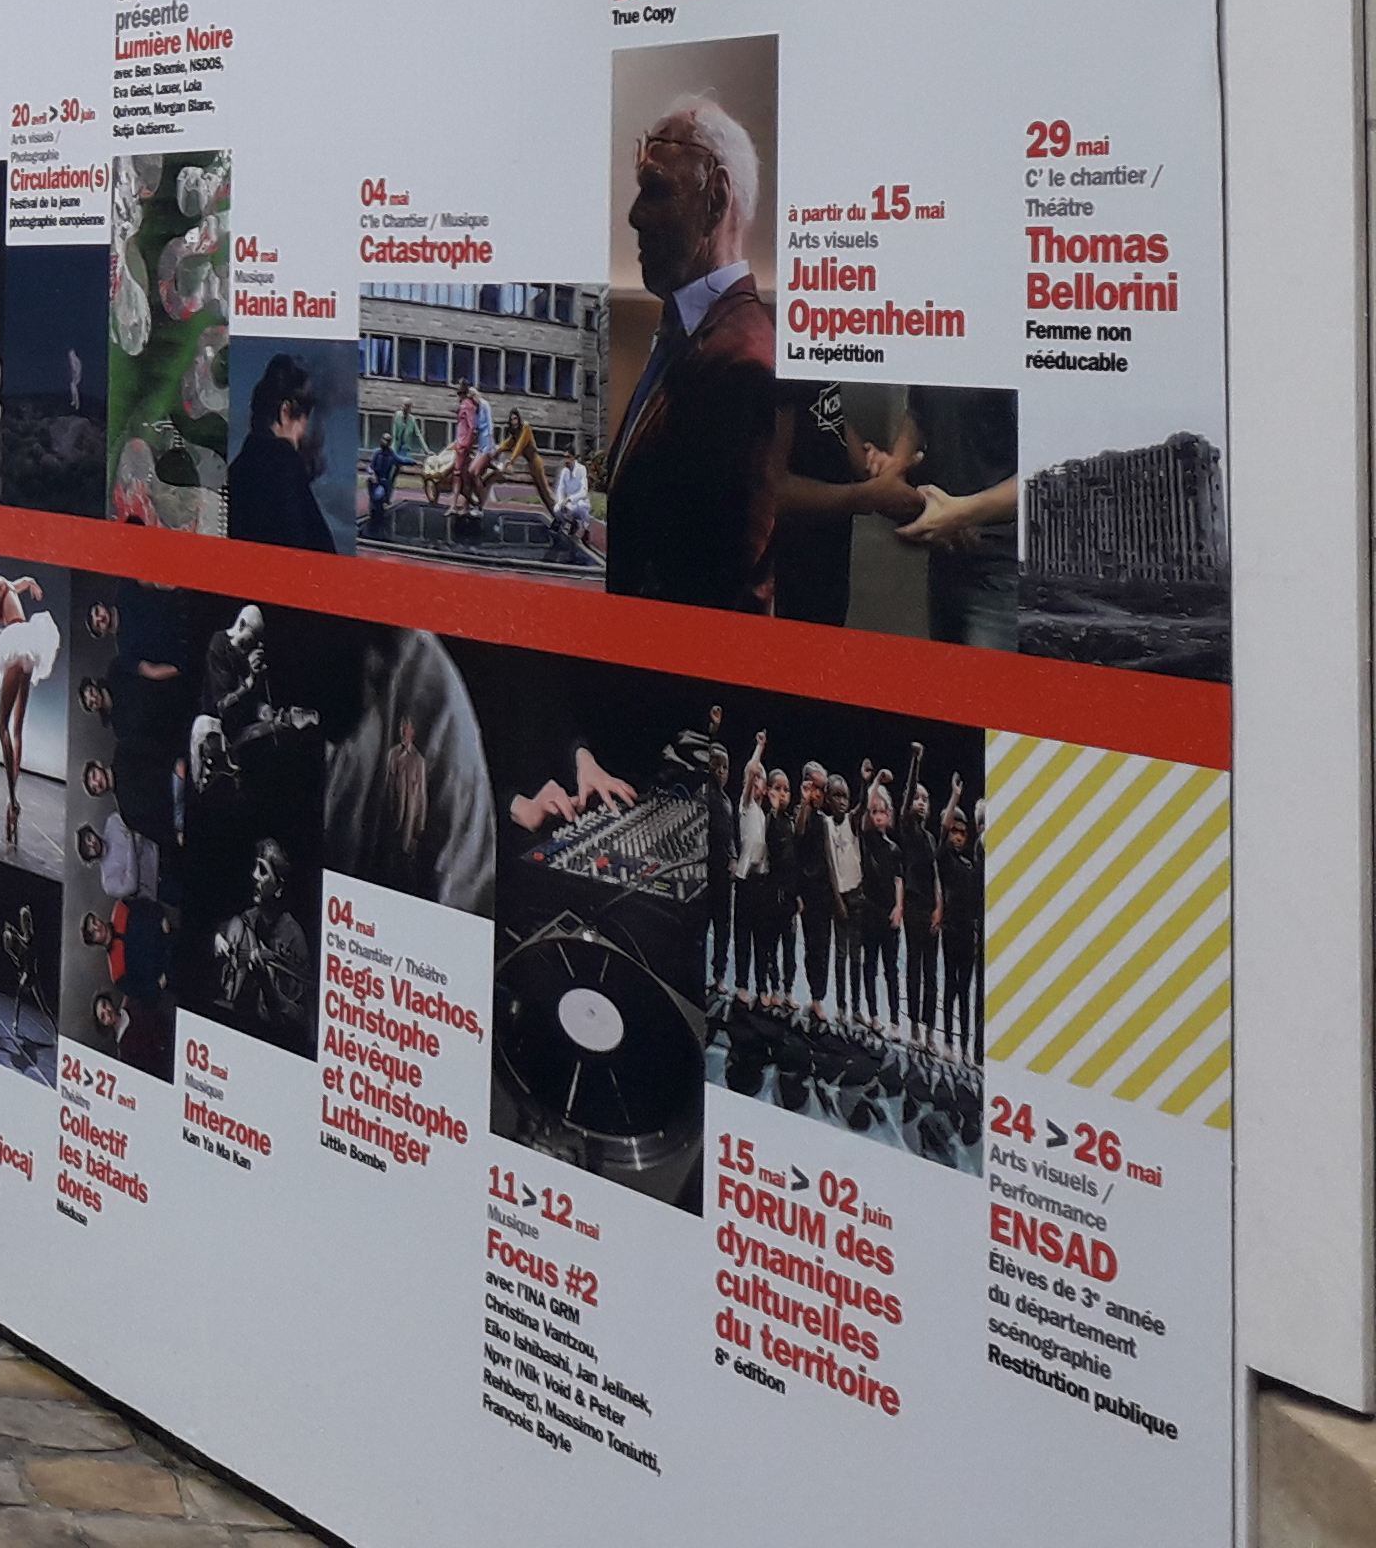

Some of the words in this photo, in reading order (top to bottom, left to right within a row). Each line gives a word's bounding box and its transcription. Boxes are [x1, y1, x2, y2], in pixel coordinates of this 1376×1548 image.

[116, 0, 188, 35] présente
[612, 10, 639, 25] True
[643, 6, 676, 24] Copy
[115, 31, 181, 60] Lumière
[186, 24, 233, 52] Noire
[12, 103, 30, 126] 20
[60, 98, 79, 122] 30
[1026, 120, 1071, 158] 29
[1076, 135, 1110, 156] mai
[10, 163, 109, 192] Circulation(s)
[361, 178, 387, 206] 04
[390, 191, 409, 205] mai
[1049, 168, 1065, 187] le
[1070, 166, 1147, 186] chantier
[383, 213, 428, 228] Chantier
[441, 213, 489, 229] Musique
[788, 205, 797, 221] à
[802, 204, 843, 225] partir
[847, 204, 866, 220] du
[871, 185, 911, 220] 15
[915, 200, 945, 219] mai
[1025, 198, 1094, 217] Théâtre
[235, 236, 258, 262] 04
[360, 235, 492, 270] Catastrophe
[788, 231, 820, 248] Arts
[824, 230, 879, 248] visuels
[1025, 226, 1169, 263] Thomas
[788, 256, 876, 291] Julien
[1027, 272, 1178, 311] Bellorini
[235, 290, 287, 316] Hania
[293, 290, 336, 318] Rani
[788, 299, 965, 341] Oppenheim
[1026, 320, 1091, 340] Femme
[1097, 326, 1132, 341] non
[788, 343, 804, 359] La
[809, 343, 884, 364] répétition
[1025, 350, 1128, 372] rééducable
[328, 896, 354, 930] 04
[356, 920, 375, 938] mai
[348, 939, 393, 967] Chantier
[406, 957, 448, 985] Théâtre
[326, 954, 385, 1000] Régis
[391, 975, 483, 1044] Vlachos,
[325, 990, 440, 1057] Christophe
[187, 1039, 209, 1071] 03
[324, 1025, 422, 1088] Alévêque
[184, 1092, 271, 1156] Interzone
[323, 1065, 344, 1094] et
[350, 1072, 468, 1144] Christophe
[60, 1105, 128, 1159] Collectif
[320, 1131, 347, 1155] Little
[350, 1143, 387, 1172] Bombe
[322, 1094, 430, 1166] Luthringer
[990, 1096, 1036, 1144] 24
[1074, 1122, 1122, 1171] 26
[1127, 1160, 1163, 1188] mai
[59, 1134, 82, 1169] les
[87, 1149, 148, 1203] bâtards
[718, 1133, 754, 1175] 15
[759, 1166, 786, 1188] mai
[820, 1170, 858, 1217] 02
[862, 1201, 892, 1230] juin
[990, 1143, 1027, 1172] Arts
[1032, 1160, 1098, 1197] visuels
[58, 1170, 102, 1212] dorés
[990, 1173, 1107, 1232] Performance
[487, 1204, 539, 1239] Musique
[575, 1218, 600, 1240] mai
[718, 1174, 826, 1249] FORUM
[836, 1224, 894, 1275] des
[990, 1202, 1117, 1282] ENSAD
[487, 1227, 559, 1288] Focus
[565, 1264, 598, 1306] #2
[717, 1221, 902, 1324] dynamiques
[486, 1271, 515, 1294] avec
[550, 1296, 580, 1326] GRM
[989, 1247, 1048, 1291] Élèves
[1053, 1278, 1076, 1303] de
[1106, 1300, 1166, 1337] année
[485, 1293, 539, 1333] Christina
[543, 1319, 598, 1364] Vantzou,
[717, 1270, 879, 1361] culturelles
[988, 1283, 1010, 1308] du
[1015, 1294, 1138, 1359] département
[485, 1318, 510, 1343] Eiko
[514, 1331, 573, 1378] Ishibashi,
[576, 1363, 597, 1387] Jan
[602, 1374, 652, 1418] Jelinek,
[716, 1306, 751, 1350] du
[760, 1323, 900, 1416] territoire
[988, 1316, 1112, 1380] scénographie
[484, 1342, 512, 1370] Npvr
[515, 1358, 540, 1385] (Nik
[544, 1371, 571, 1402] Void
[575, 1388, 586, 1407] &
[590, 1395, 626, 1428] Peter
[734, 1356, 786, 1394] édition
[988, 1342, 1090, 1404] Restitution
[1095, 1390, 1178, 1441] publique
[483, 1393, 534, 1434] François
[537, 1421, 573, 1454] Bayle
[484, 1368, 542, 1415] Rehberg),
[546, 1399, 604, 1443] Massimo
[607, 1429, 662, 1477] Toniutti,
